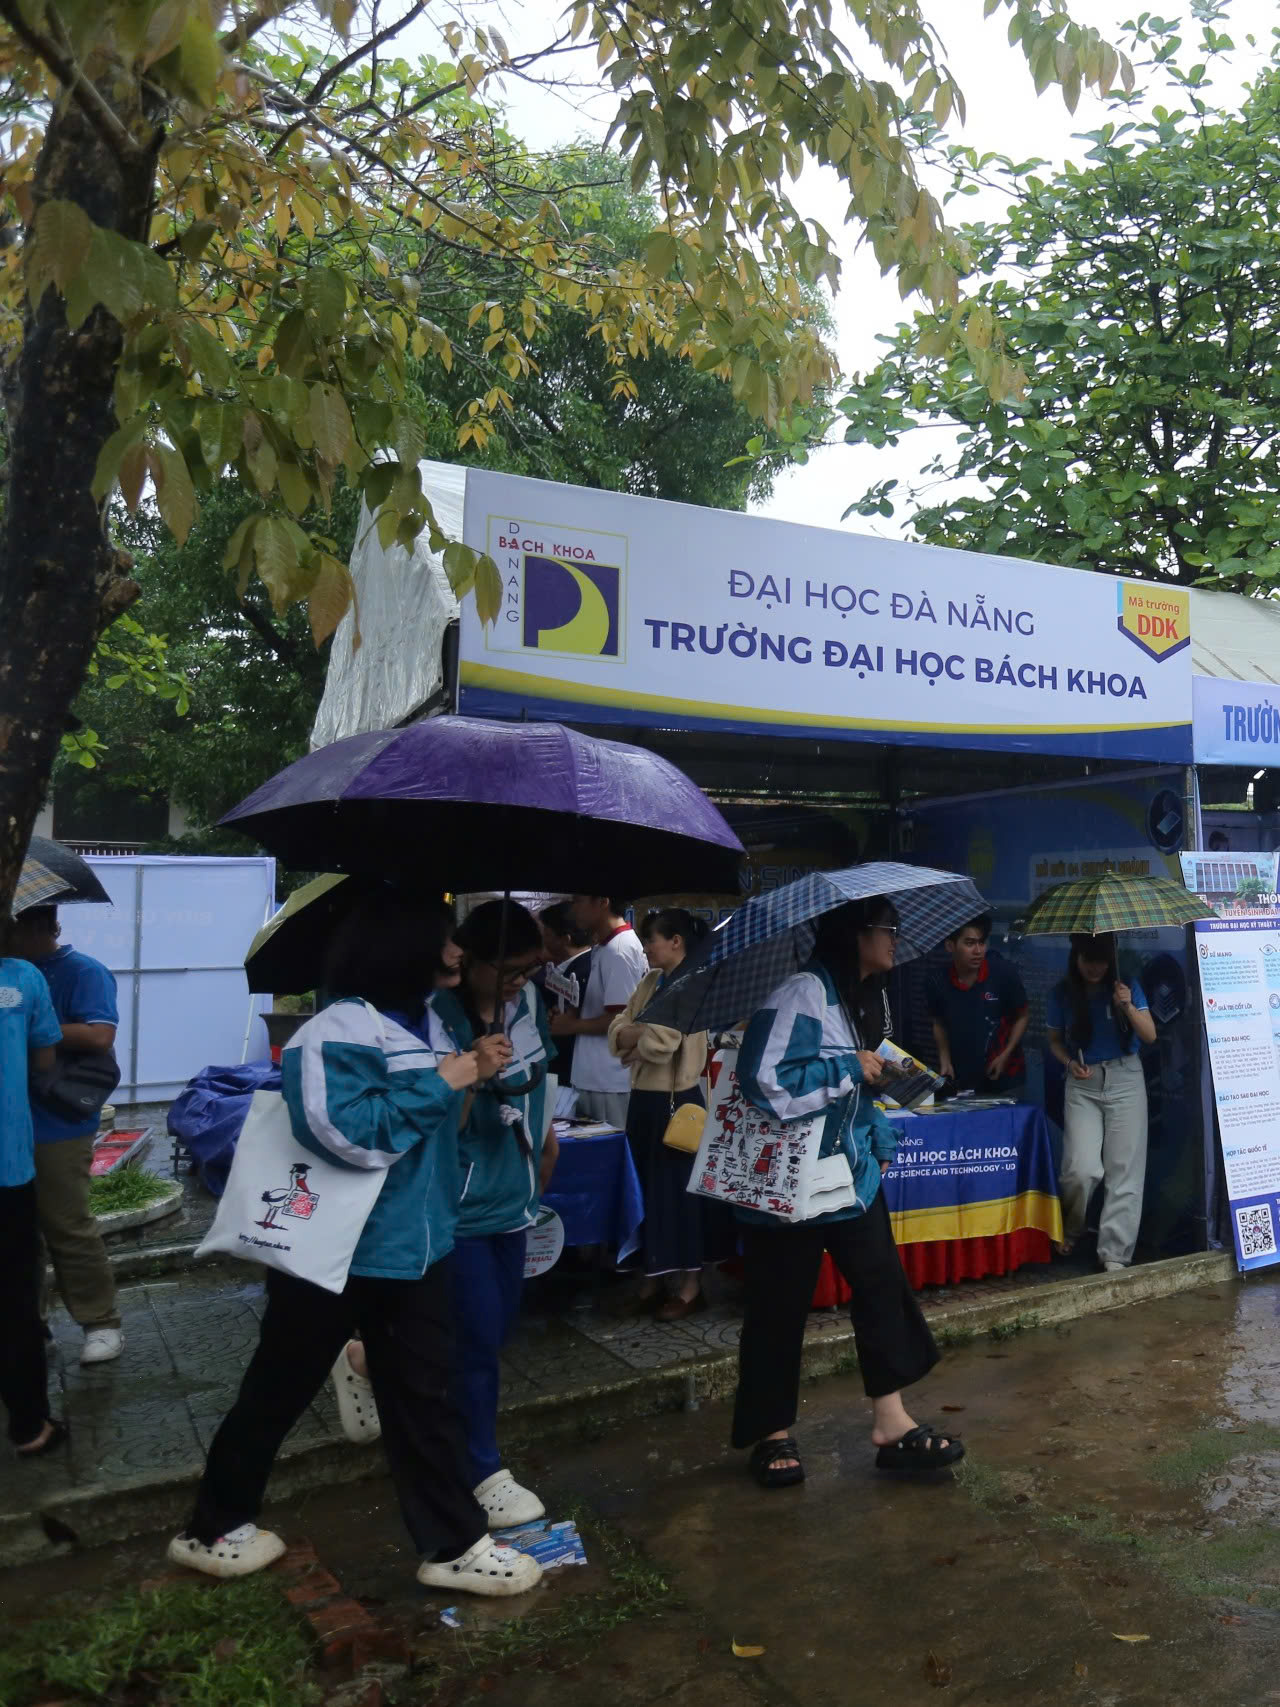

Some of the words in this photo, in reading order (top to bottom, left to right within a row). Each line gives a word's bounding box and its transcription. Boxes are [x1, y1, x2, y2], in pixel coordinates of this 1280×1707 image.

[553, 544, 595, 561] KHOA
[728, 569, 791, 609] ĐẠI
[805, 580, 880, 619] HỌC
[890, 590, 937, 624] ĐÀ
[947, 593, 1034, 636] NẴNG
[1128, 595, 1144, 608] Mã
[1145, 598, 1180, 616] trường
[1137, 613, 1179, 640] DDK
[644, 618, 812, 664] TRƯỜNG
[822, 640, 884, 679] ĐẠI
[895, 648, 966, 686] HỌC
[975, 654, 1058, 690] BÁCH
[1067, 668, 1148, 700] KHOA
[1247, 907, 1265, 916] SINH
[897, 1152, 917, 1166] ĐẠI
[920, 1151, 947, 1164] HỌC
[950, 1147, 981, 1160] BÁCH
[984, 1146, 1018, 1159] KHOA
[901, 1169, 930, 1178] SCIENCE
[932, 1168, 948, 1176] AND
[950, 1165, 1000, 1175] TECHNOLOGY
[1005, 1163, 1016, 1171] UD
